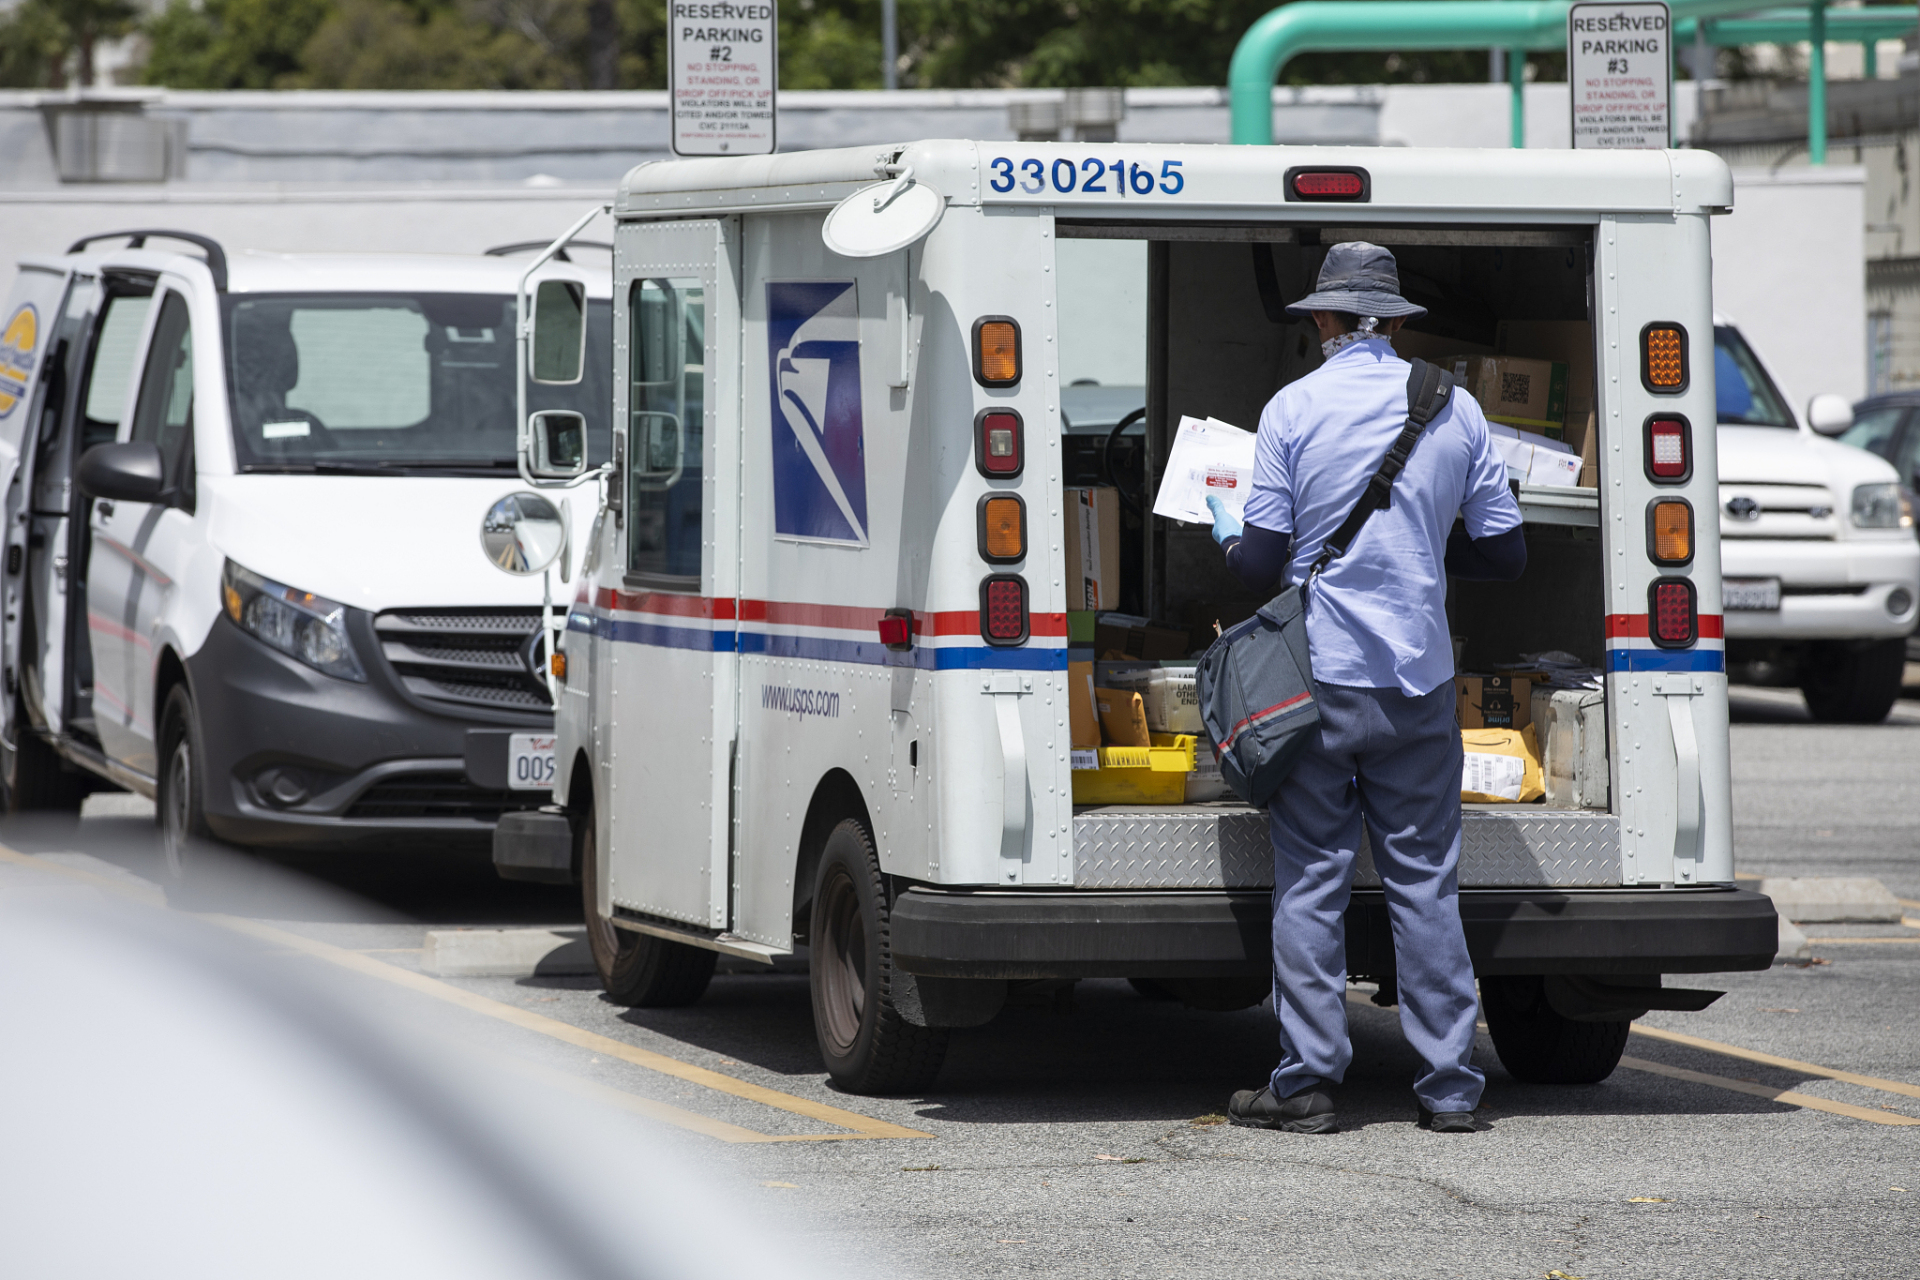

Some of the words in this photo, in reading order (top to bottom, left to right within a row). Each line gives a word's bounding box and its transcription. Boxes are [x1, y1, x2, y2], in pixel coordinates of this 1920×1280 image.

[674, 4, 772, 19] RESERVED
[1574, 17, 1666, 32] RESERVED
[683, 28, 763, 43] PARKING
[710, 46, 732, 61] #2
[1582, 39, 1658, 54] PARKING
[687, 63, 703, 72] NO
[1607, 59, 1628, 74] #3
[990, 157, 1185, 196] 3302165
[762, 684, 840, 722] www.usps.com
